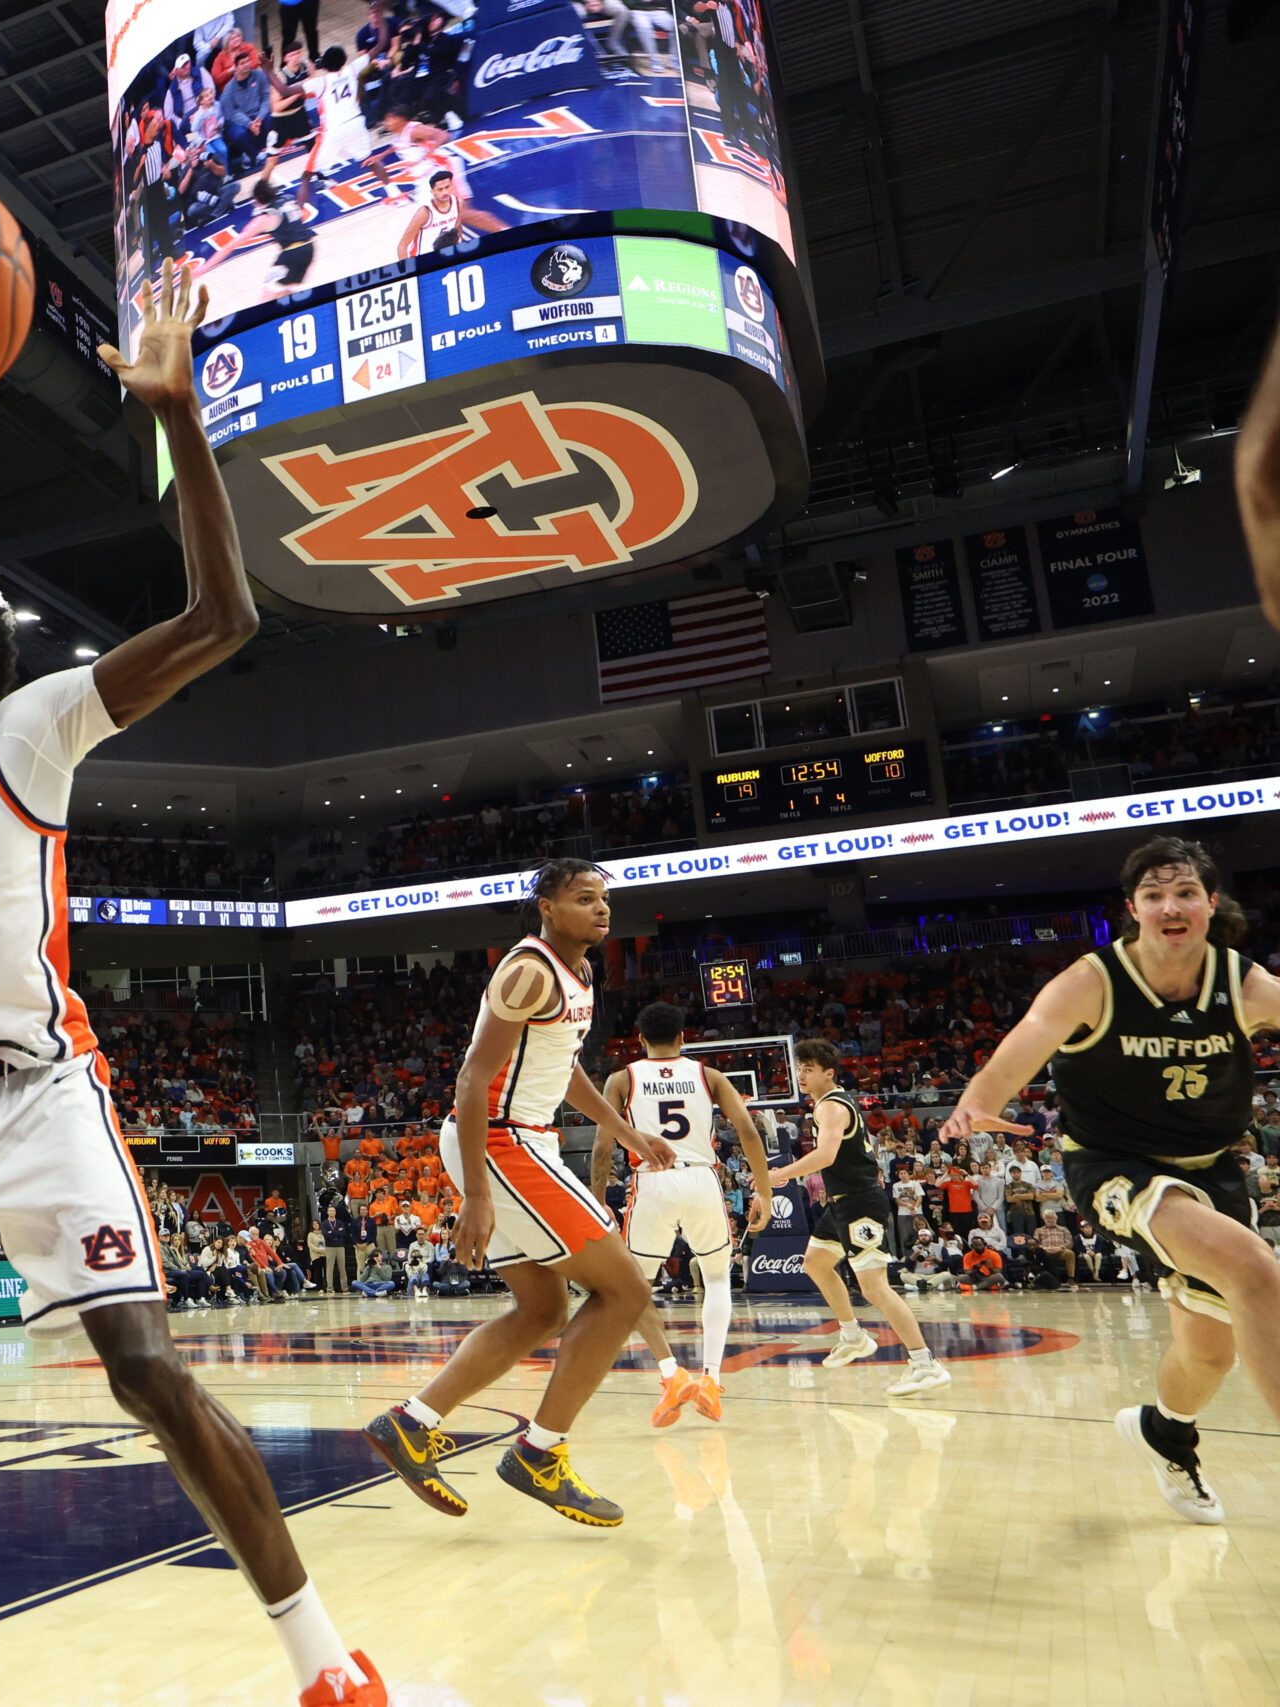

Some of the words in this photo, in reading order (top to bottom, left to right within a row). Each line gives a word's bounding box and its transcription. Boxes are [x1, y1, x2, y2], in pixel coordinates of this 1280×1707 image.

[441, 264, 487, 317] 10
[345, 282, 412, 331] 12:54
[539, 302, 594, 321] WOFFORD
[278, 313, 318, 364] 19
[376, 330, 404, 349] HALF
[439, 334, 448, 348] 4
[458, 321, 502, 341] FOULS
[527, 330, 594, 349] TIMEOUTS
[601, 328, 608, 340] 4
[376, 362, 393, 380] 24
[271, 375, 310, 395] FOULS
[320, 368, 327, 382] 1
[208, 395, 239, 421] AUBURN
[1056, 520, 1121, 539] GYMNASTICS
[980, 554, 1018, 569] CIAMPI
[1050, 557, 1093, 573] FINAL
[1096, 548, 1138, 564] FOUR
[912, 567, 944, 582] SMITH
[1082, 593, 1120, 608] 2022
[864, 749, 905, 764] WOFFORD
[716, 769, 760, 785] AUBURN
[791, 762, 838, 782] 12:54
[885, 763, 901, 779] 10
[738, 784, 753, 799] 19
[836, 793, 845, 803] 4
[1126, 799, 1175, 819] GET
[1182, 788, 1264, 813] LOUD!
[943, 821, 988, 839] GET
[996, 811, 1070, 834] LOUD!
[777, 842, 819, 860] GET
[825, 833, 893, 856] LOUD!
[622, 863, 661, 880] GET
[667, 855, 731, 876] LOUD!
[480, 880, 514, 897] GET
[827, 881, 856, 897] 107
[348, 897, 380, 913] GET
[385, 890, 439, 909] LOUD!
[177, 911, 183, 925] 2
[199, 912, 206, 925] 0
[239, 913, 254, 927] 0/0
[261, 914, 276, 927] 0/0
[710, 965, 744, 980] 12:54
[713, 980, 744, 1003] 24
[643, 1081, 696, 1095] MAGWOOD
[1162, 1064, 1208, 1101] 25
[658, 1100, 690, 1140] 5
[126, 1137, 157, 1146] AUBURN
[204, 1138, 230, 1146] WOFFORD
[255, 1148, 293, 1156] COOK'S
